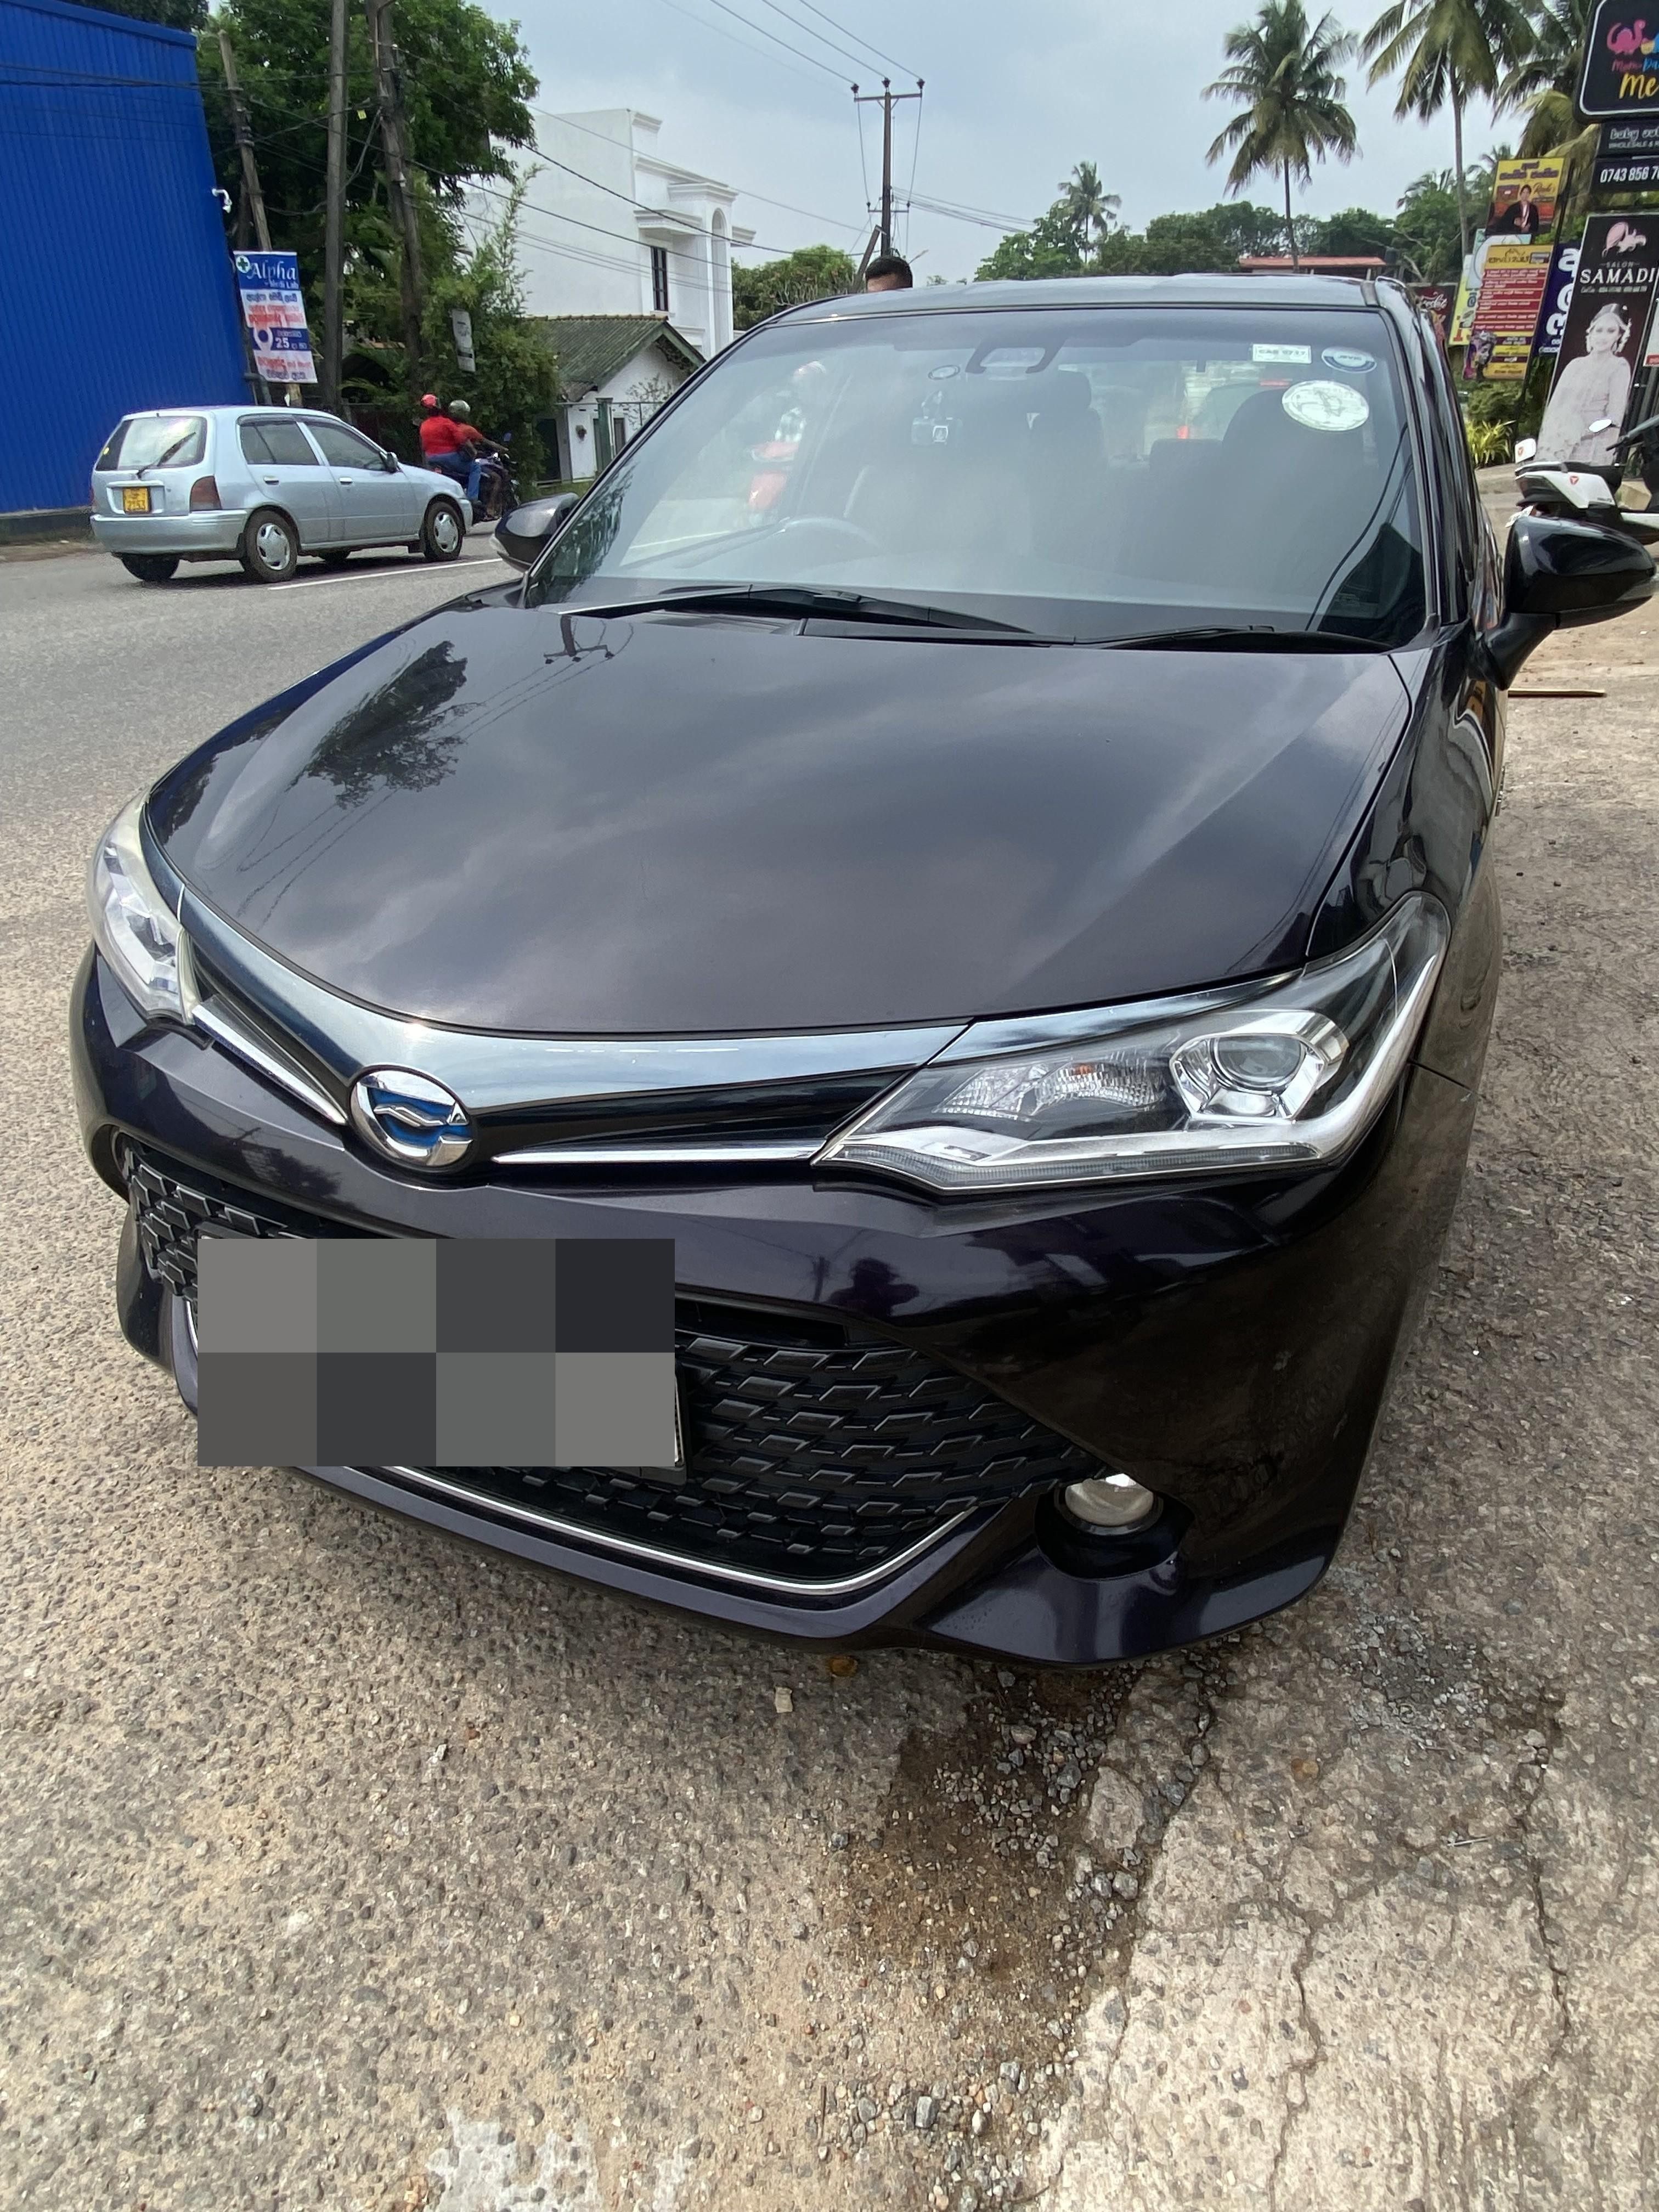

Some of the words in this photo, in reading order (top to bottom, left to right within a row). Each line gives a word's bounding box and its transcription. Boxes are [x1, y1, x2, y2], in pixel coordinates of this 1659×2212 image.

[1600, 167, 1627, 183] 0743
[246, 259, 296, 286] Alpha
[1579, 267, 1656, 284] SAMADI
[275, 337, 290, 348] 25
